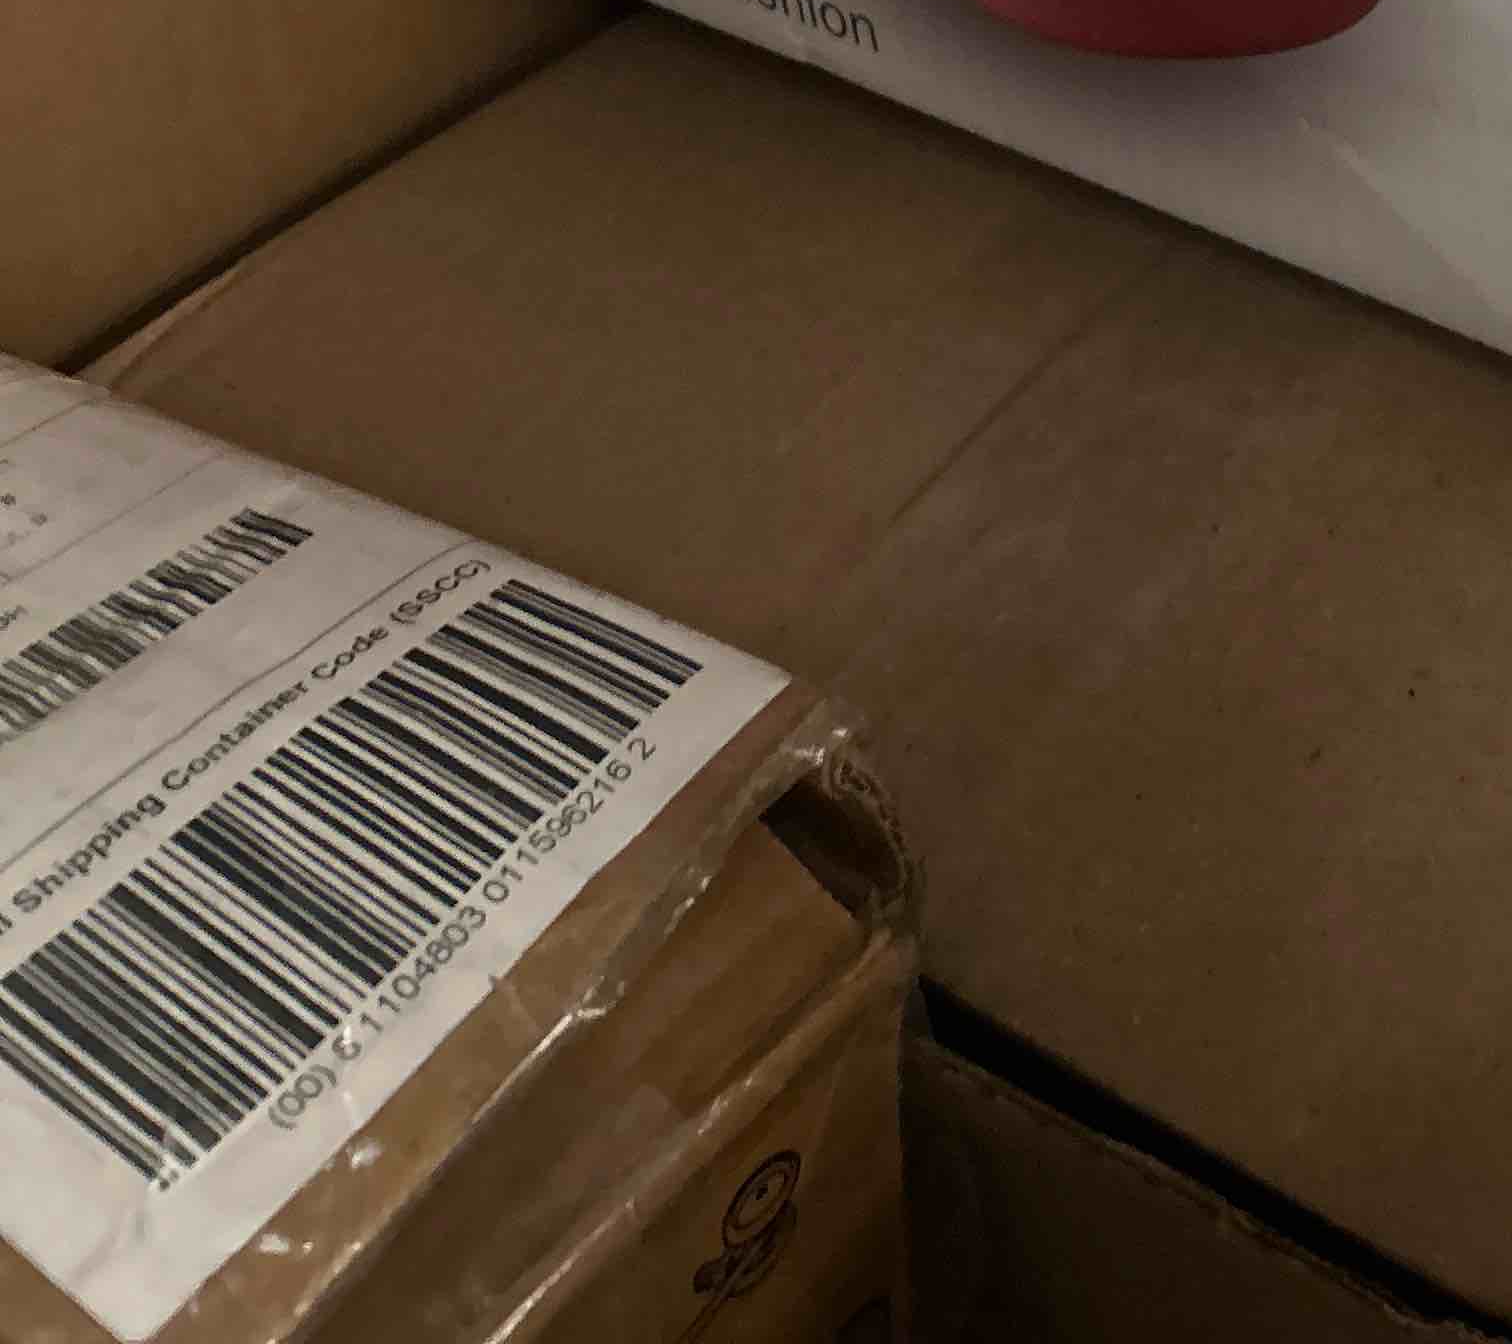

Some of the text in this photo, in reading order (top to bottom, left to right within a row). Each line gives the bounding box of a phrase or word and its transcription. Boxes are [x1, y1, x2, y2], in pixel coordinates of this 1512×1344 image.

[12, 556, 492, 914] Shipping Container Code (SSCC)
[265, 1064, 338, 1132] (00)
